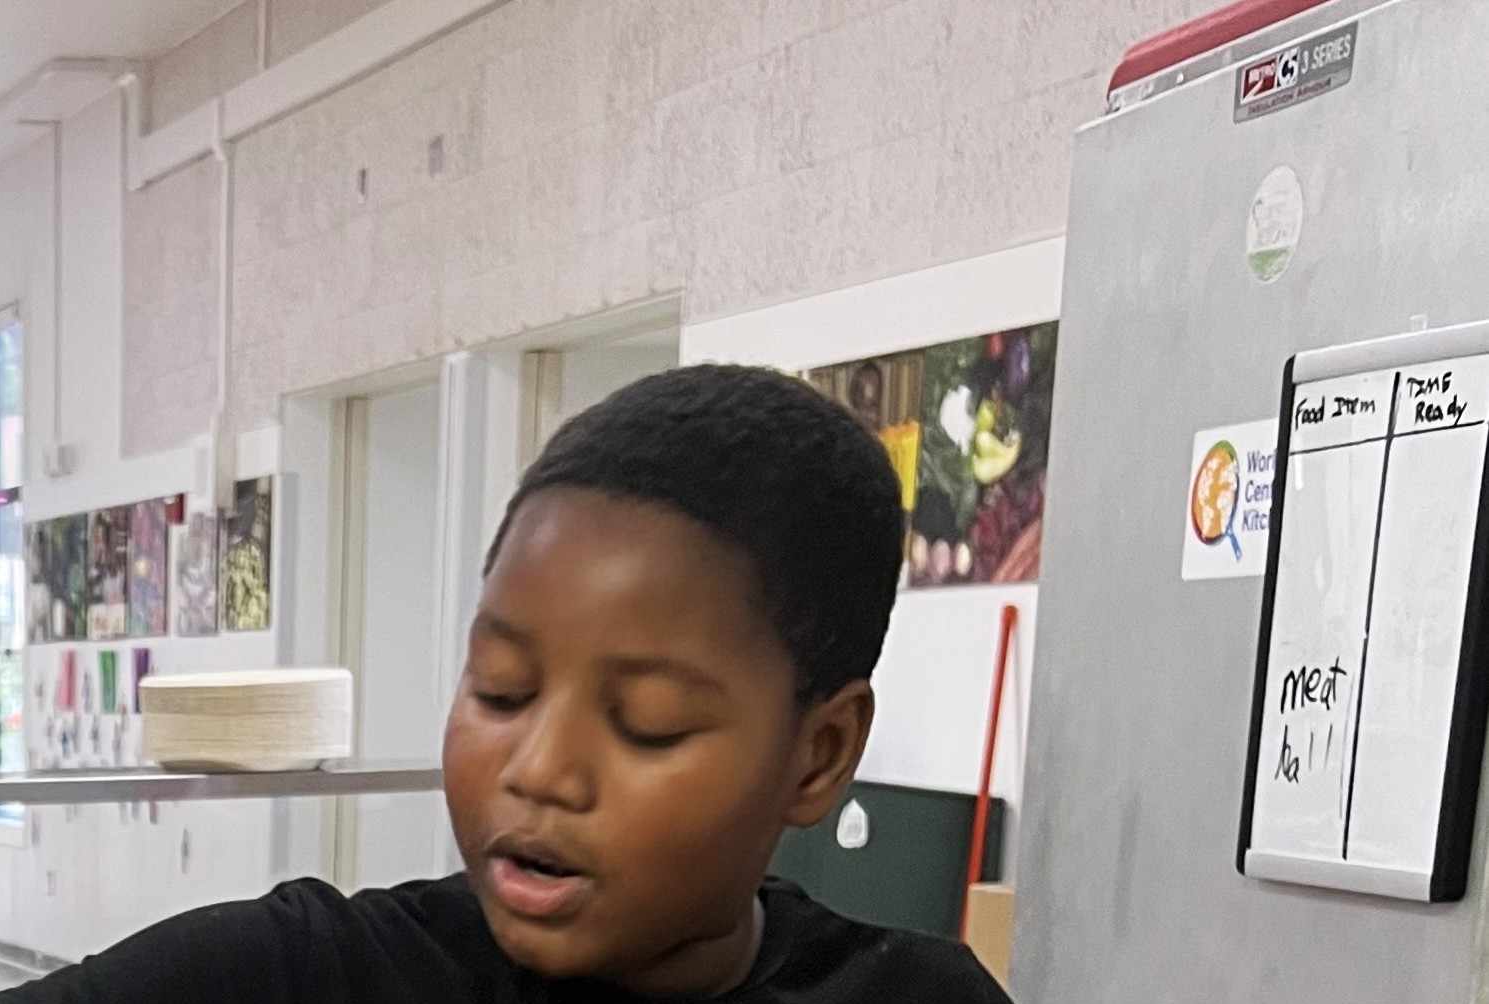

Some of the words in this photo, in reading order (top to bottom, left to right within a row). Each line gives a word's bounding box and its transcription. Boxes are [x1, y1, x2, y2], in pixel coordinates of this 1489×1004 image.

[1312, 33, 1351, 70] SERIES
[1294, 396, 1325, 431] Food
[1414, 394, 1468, 426] Ready
